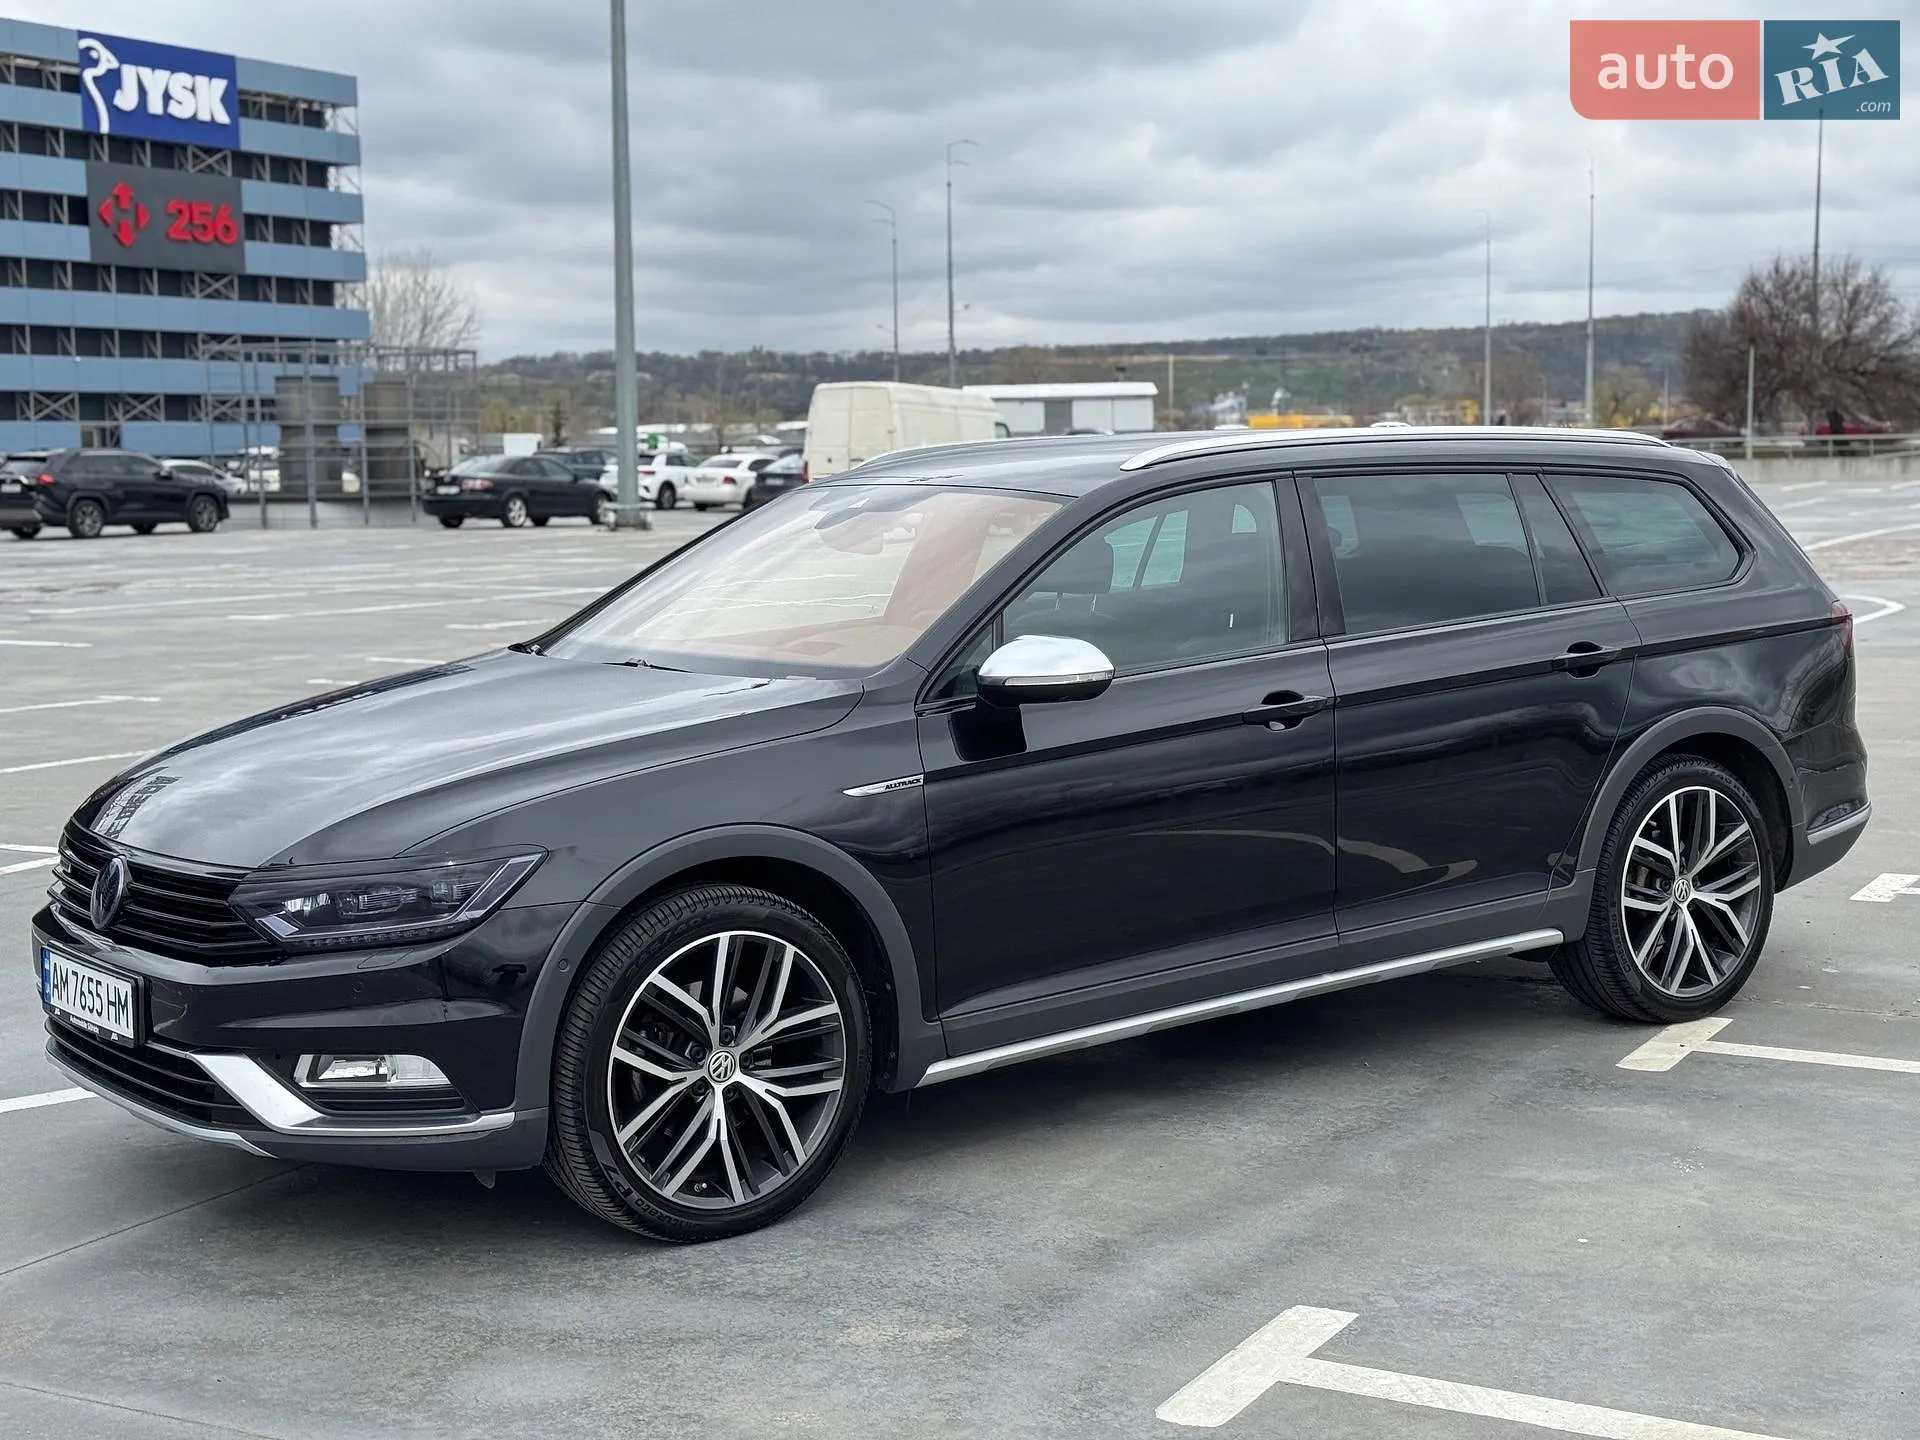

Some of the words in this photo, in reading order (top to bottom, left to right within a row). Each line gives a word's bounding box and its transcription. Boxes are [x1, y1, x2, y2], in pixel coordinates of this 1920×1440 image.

[113, 63, 232, 125] JYSK
[166, 198, 239, 245] 256
[885, 778, 922, 790] ALLTRACK
[52, 962, 69, 1005] AM
[71, 969, 104, 1017] 7655
[106, 983, 129, 1029] HM
